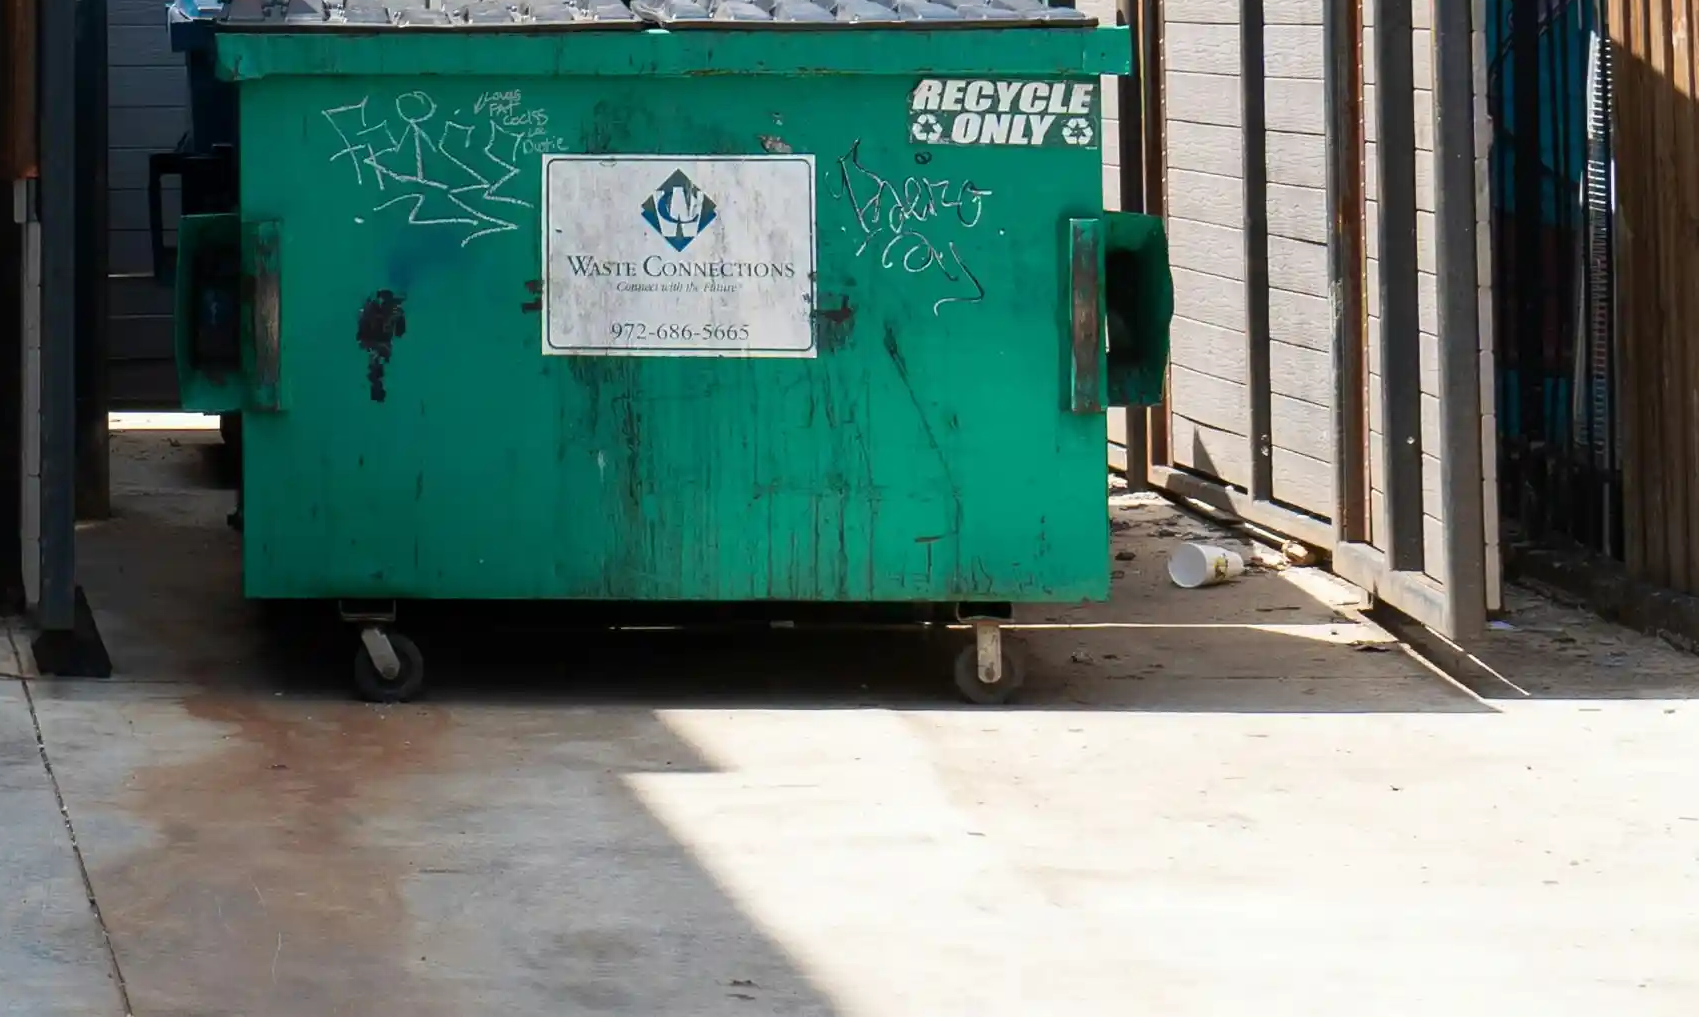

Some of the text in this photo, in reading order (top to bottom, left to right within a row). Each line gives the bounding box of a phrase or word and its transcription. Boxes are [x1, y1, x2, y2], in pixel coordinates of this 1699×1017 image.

[912, 79, 1094, 114] RECYCLE
[951, 112, 1057, 145] ONLY
[611, 323, 750, 341] 972-686-5665
